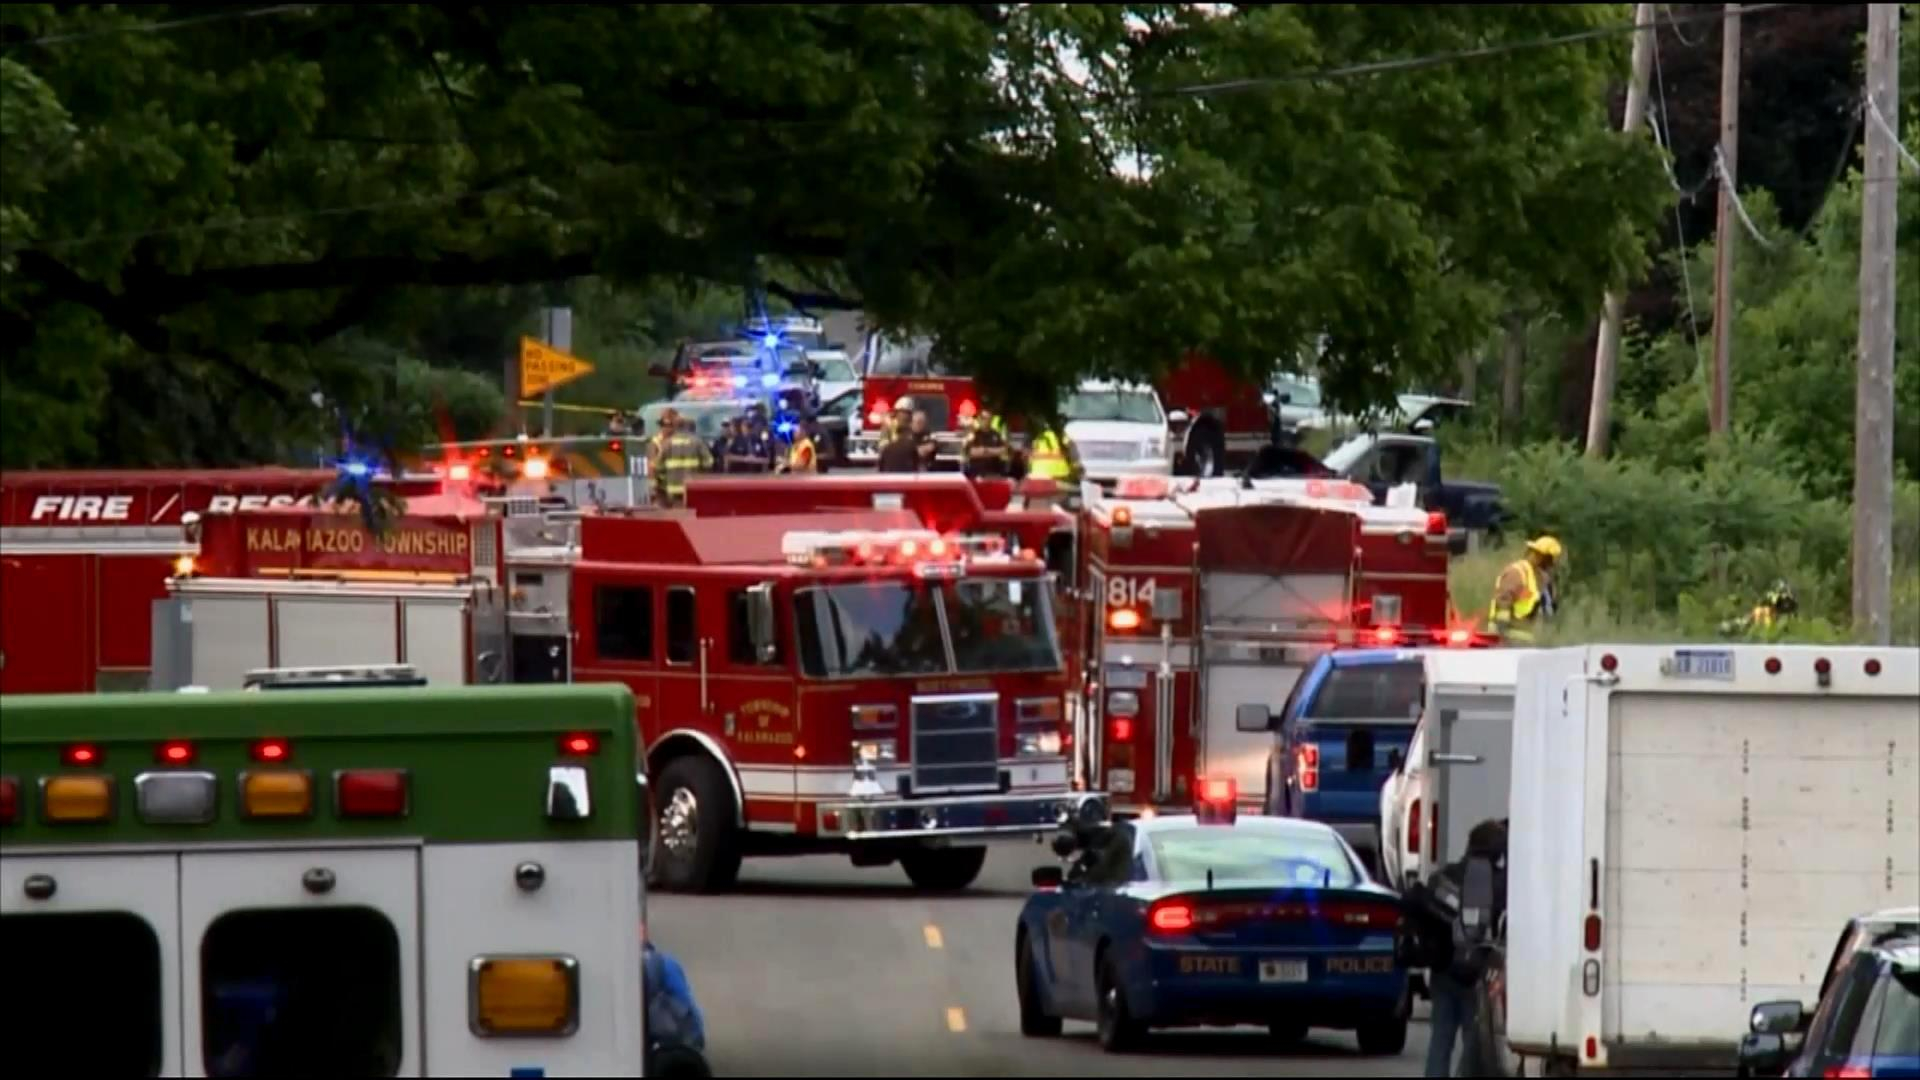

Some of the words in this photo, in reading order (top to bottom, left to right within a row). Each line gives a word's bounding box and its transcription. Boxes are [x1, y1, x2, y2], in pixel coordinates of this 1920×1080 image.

[31, 495, 134, 520] FIRE
[1108, 576, 1156, 608] 814
[1179, 956, 1240, 973] STATE
[1326, 956, 1393, 973] POLICE
